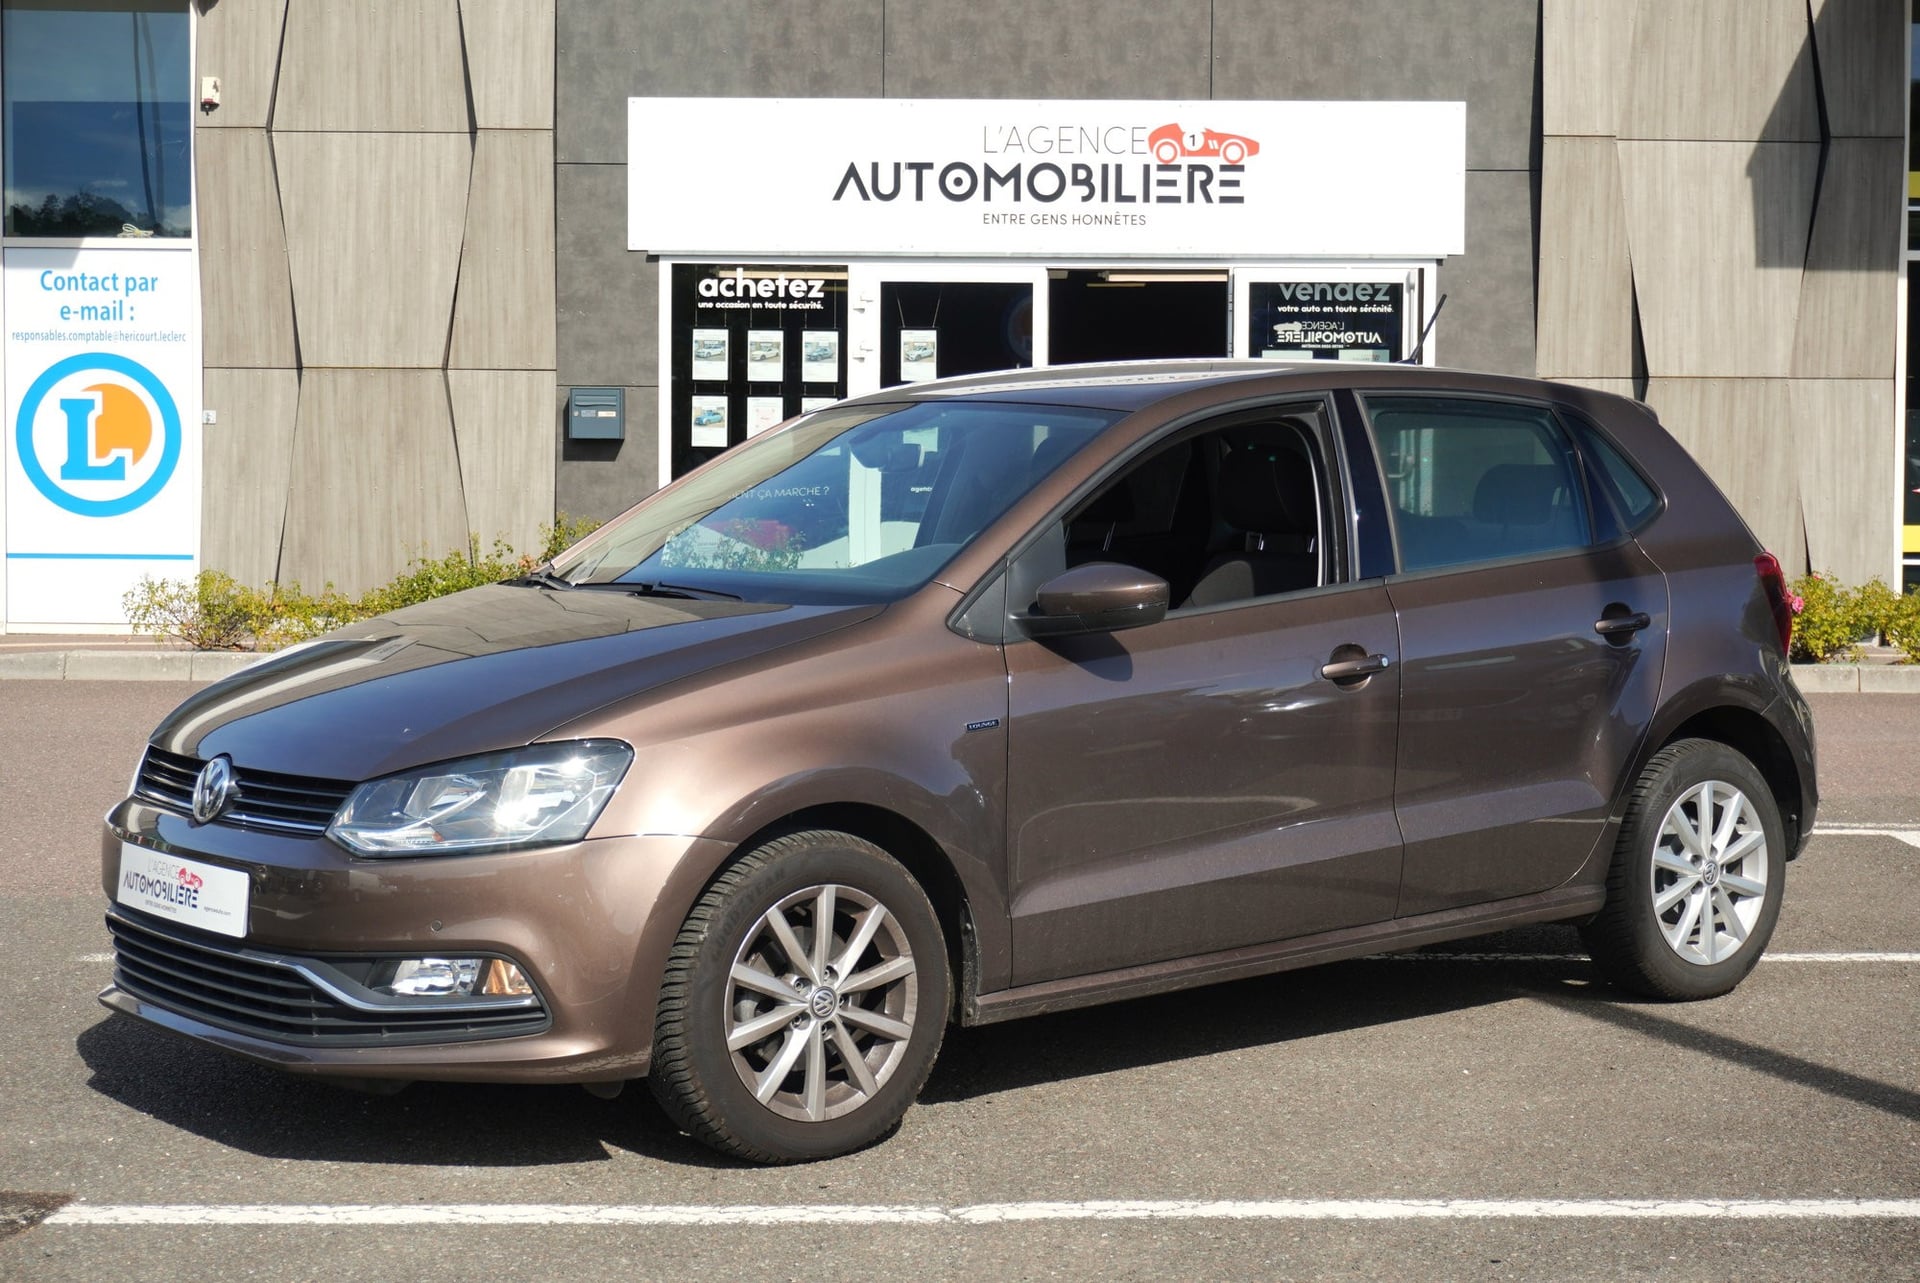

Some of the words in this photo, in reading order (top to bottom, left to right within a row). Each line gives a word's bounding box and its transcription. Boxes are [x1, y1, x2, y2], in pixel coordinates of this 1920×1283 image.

[983, 124, 1147, 154] L'AGENCE
[983, 213, 1026, 225] ENTRE
[1030, 213, 1067, 226] GENS
[1072, 211, 1147, 226] HONNÊTES
[40, 270, 119, 292] Contact
[125, 276, 158, 297] par
[698, 267, 825, 298] achetez
[60, 300, 123, 321] e-mail
[698, 301, 714, 309] une
[715, 300, 751, 309] occasion
[764, 301, 787, 309] toute
[788, 300, 824, 310] sécurité.
[1277, 305, 1299, 313] votre
[1301, 305, 1321, 313] auto
[1335, 305, 1358, 313] toute
[1359, 303, 1394, 313] sérénité.
[774, 487, 821, 498] MARCHE
